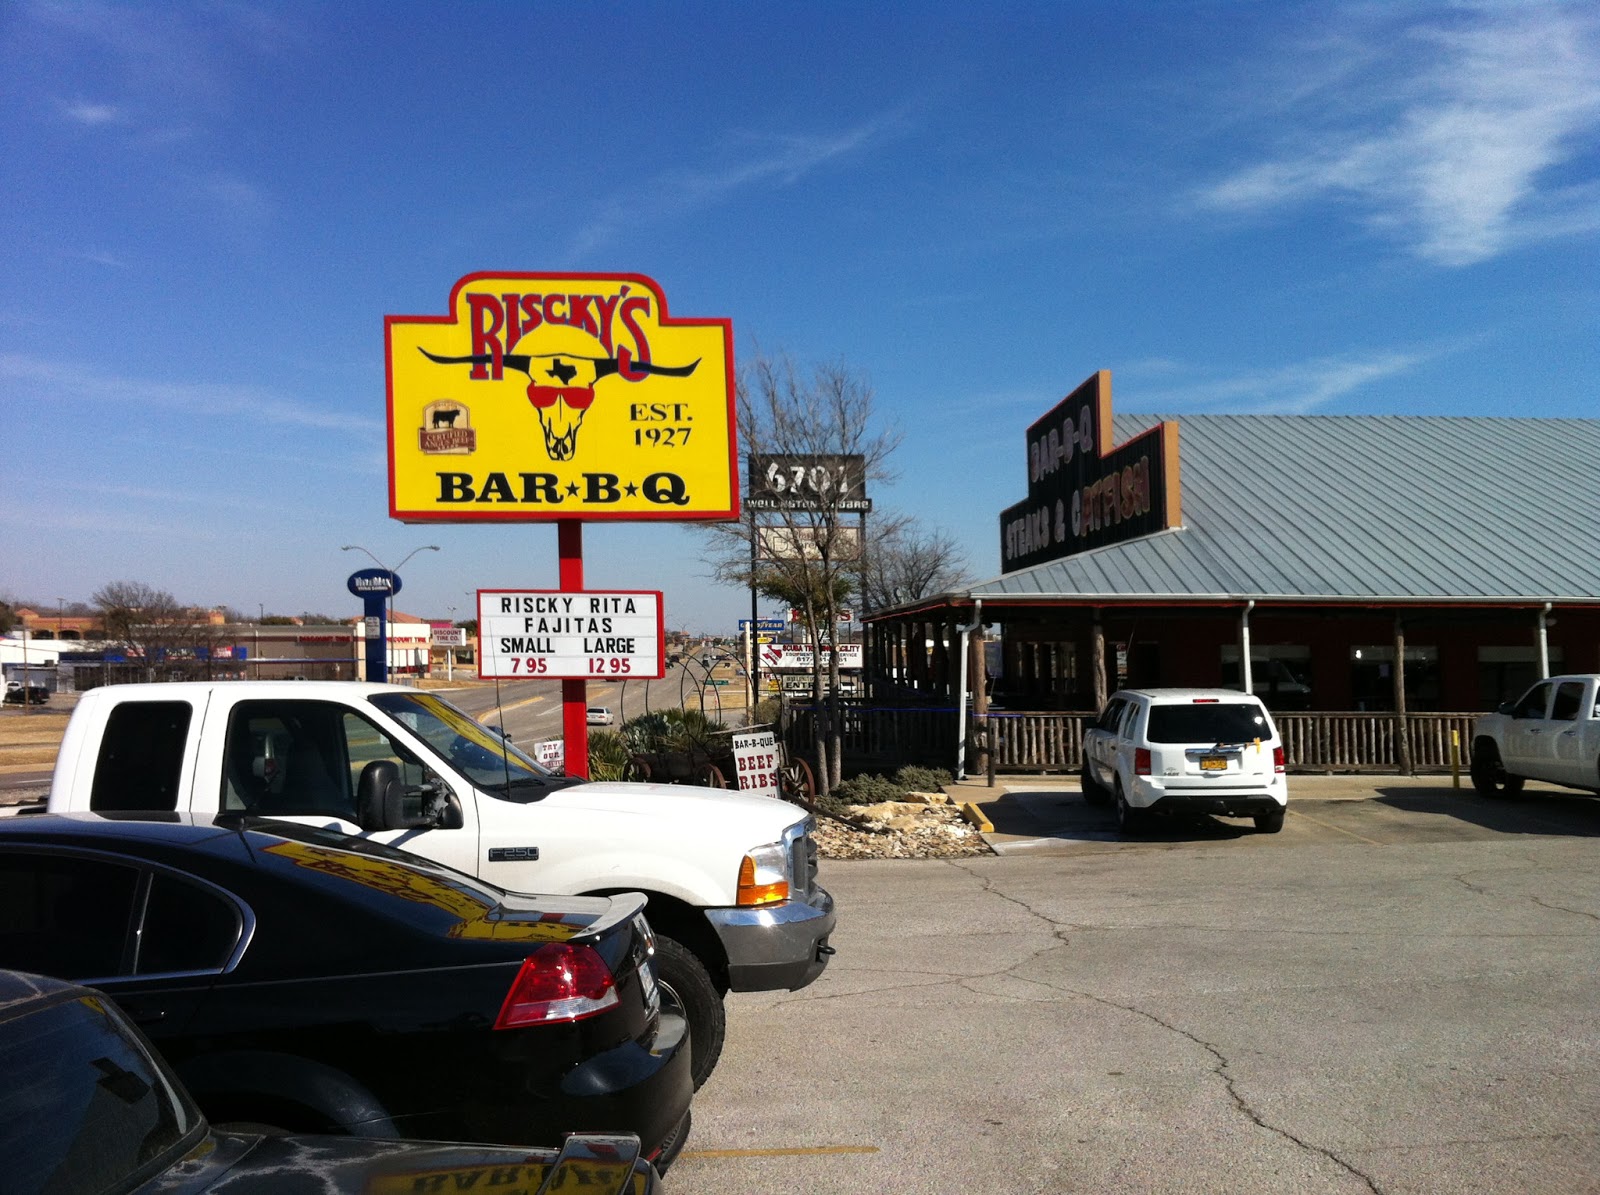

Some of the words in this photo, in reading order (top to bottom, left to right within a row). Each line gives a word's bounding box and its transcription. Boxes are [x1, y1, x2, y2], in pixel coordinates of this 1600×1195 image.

[466, 285, 651, 382] RISCKY'S
[630, 403, 693, 422] EST.
[633, 427, 692, 448] 1927
[1006, 506, 1049, 560] STEAKS
[1071, 455, 1150, 537] CATFISH
[501, 597, 573, 613] RISCKY
[590, 598, 636, 614] RITA
[524, 617, 612, 633] FAJITAS
[501, 638, 555, 653] SMALL
[584, 638, 635, 654] LARGE
[782, 644, 803, 652] SCUBA
[542, 743, 558, 751] TRY
[734, 737, 773, 749] BAR-B-QUE
[543, 751, 560, 759] OUR
[738, 754, 774, 771] BEEF
[739, 773, 778, 790] RIBS
